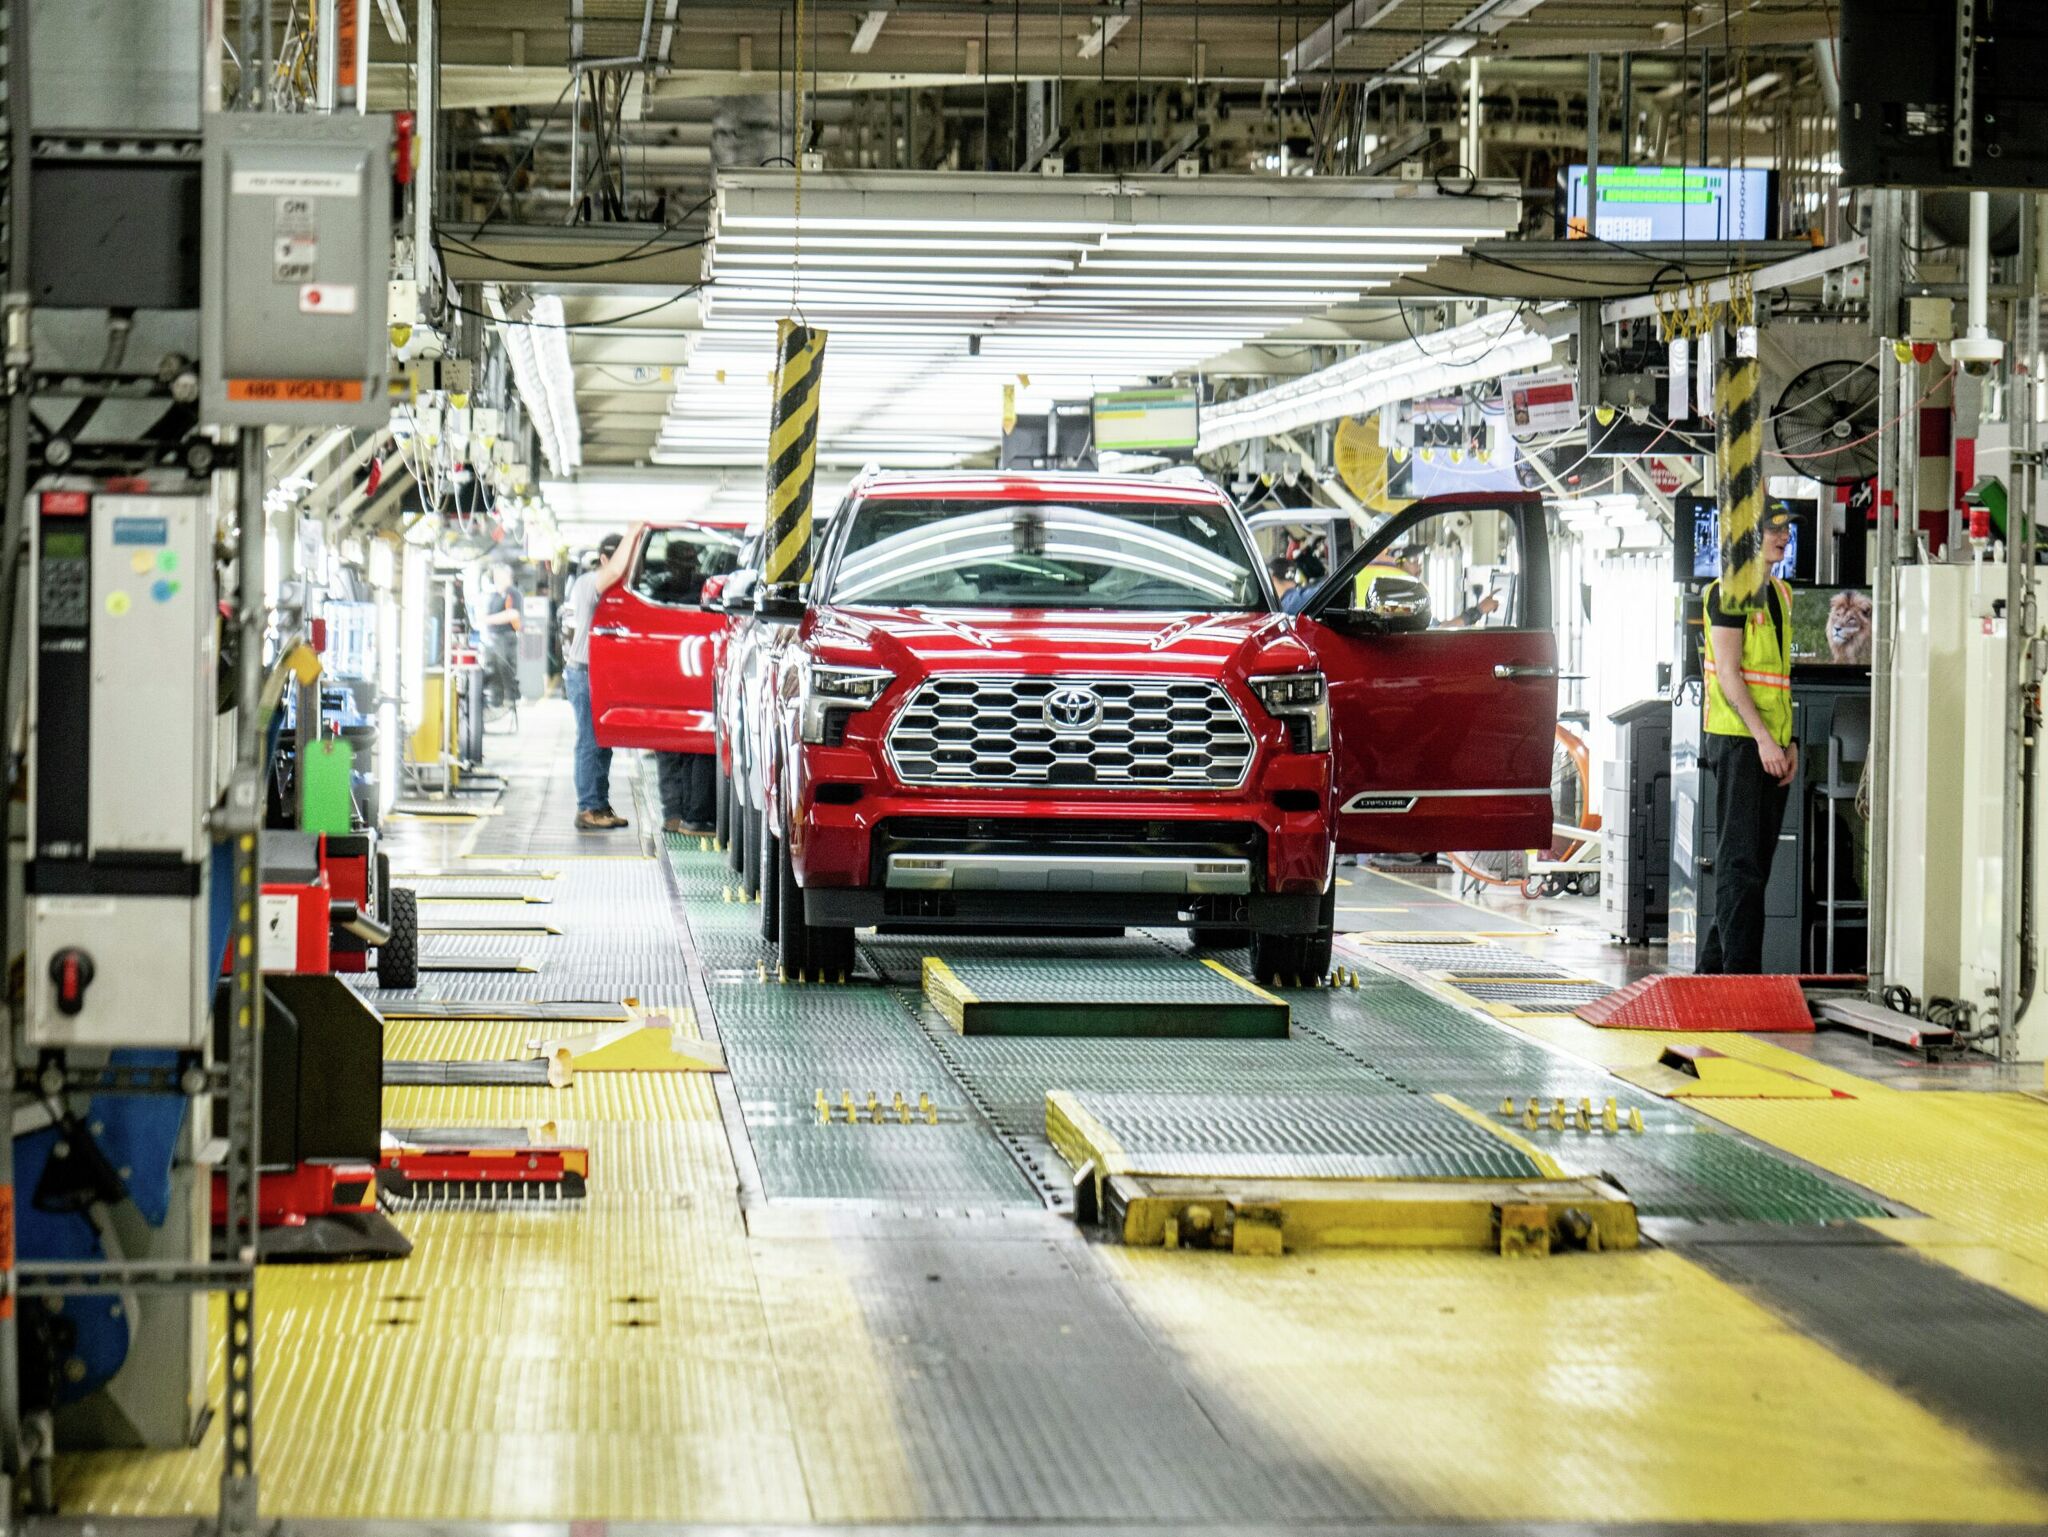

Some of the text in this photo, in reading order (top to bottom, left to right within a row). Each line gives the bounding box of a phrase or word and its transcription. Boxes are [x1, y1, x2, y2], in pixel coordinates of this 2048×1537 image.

[339, 0, 355, 29] VO
[283, 200, 308, 213] ON
[278, 264, 310, 278] OFF
[245, 381, 344, 398] 480 VOLTS
